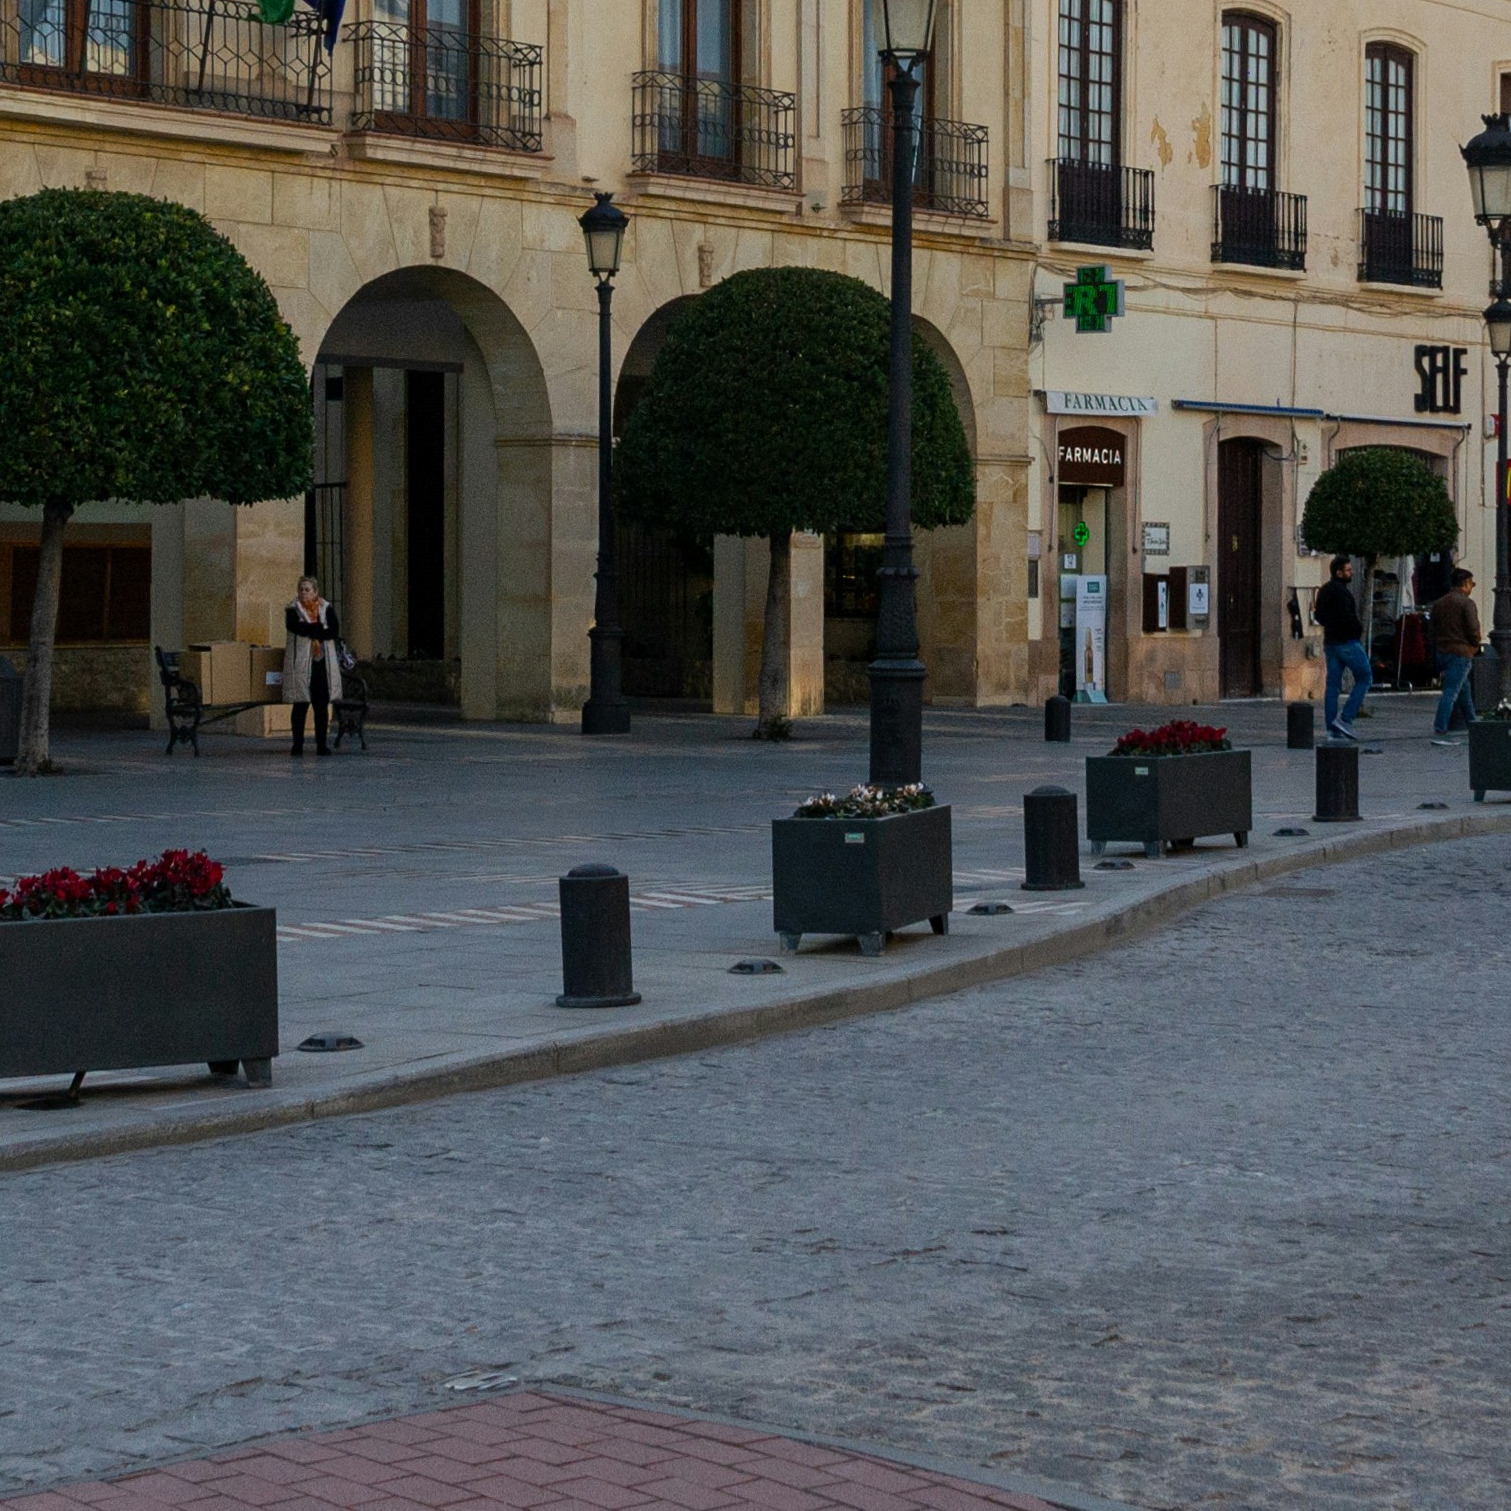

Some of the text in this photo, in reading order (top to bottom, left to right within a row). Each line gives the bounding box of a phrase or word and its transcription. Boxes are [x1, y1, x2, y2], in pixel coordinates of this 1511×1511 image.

[1414, 345, 1468, 415] SELF
[1063, 392, 1149, 412] FARMACIA
[1058, 446, 1122, 465] FARMACIA
